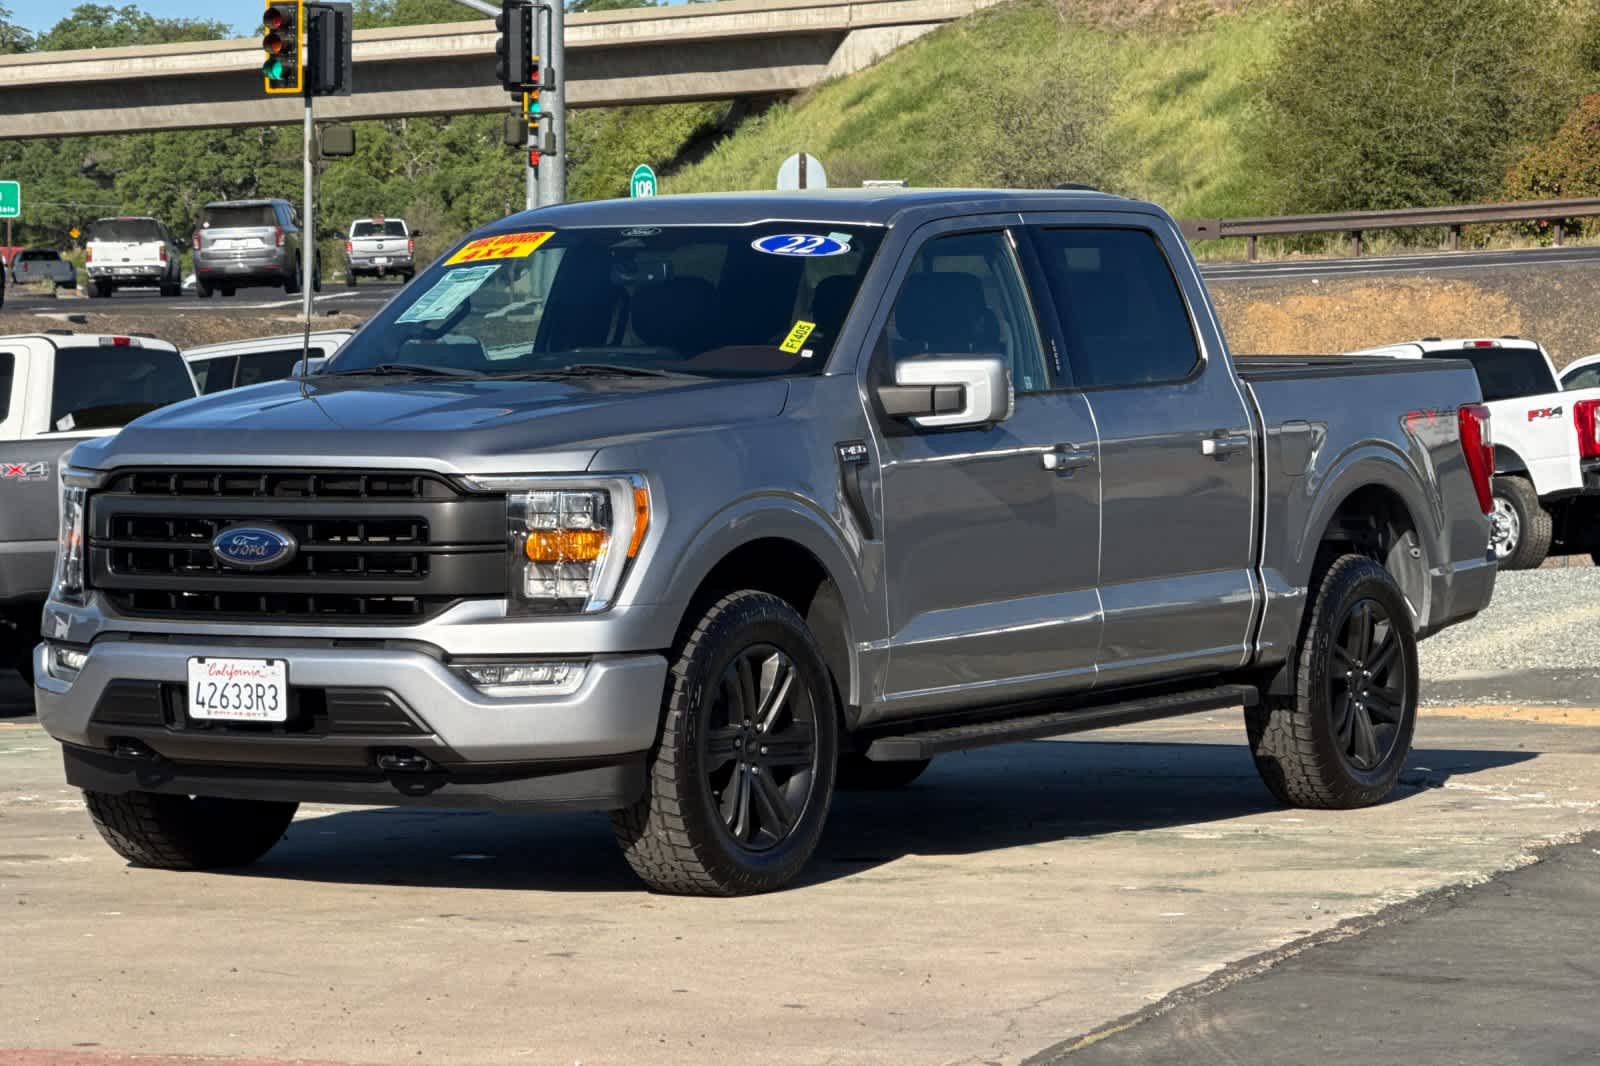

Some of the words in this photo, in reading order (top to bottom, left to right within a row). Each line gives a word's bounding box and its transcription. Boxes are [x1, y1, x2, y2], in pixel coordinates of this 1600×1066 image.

[635, 181, 653, 198] 108
[773, 236, 825, 253] 22
[785, 324, 812, 349] F1405
[1528, 405, 1563, 422] FX4
[0, 462, 48, 477] X4
[229, 535, 269, 555] Ford
[208, 662, 265, 681] California
[196, 682, 278, 711] 42633R3
